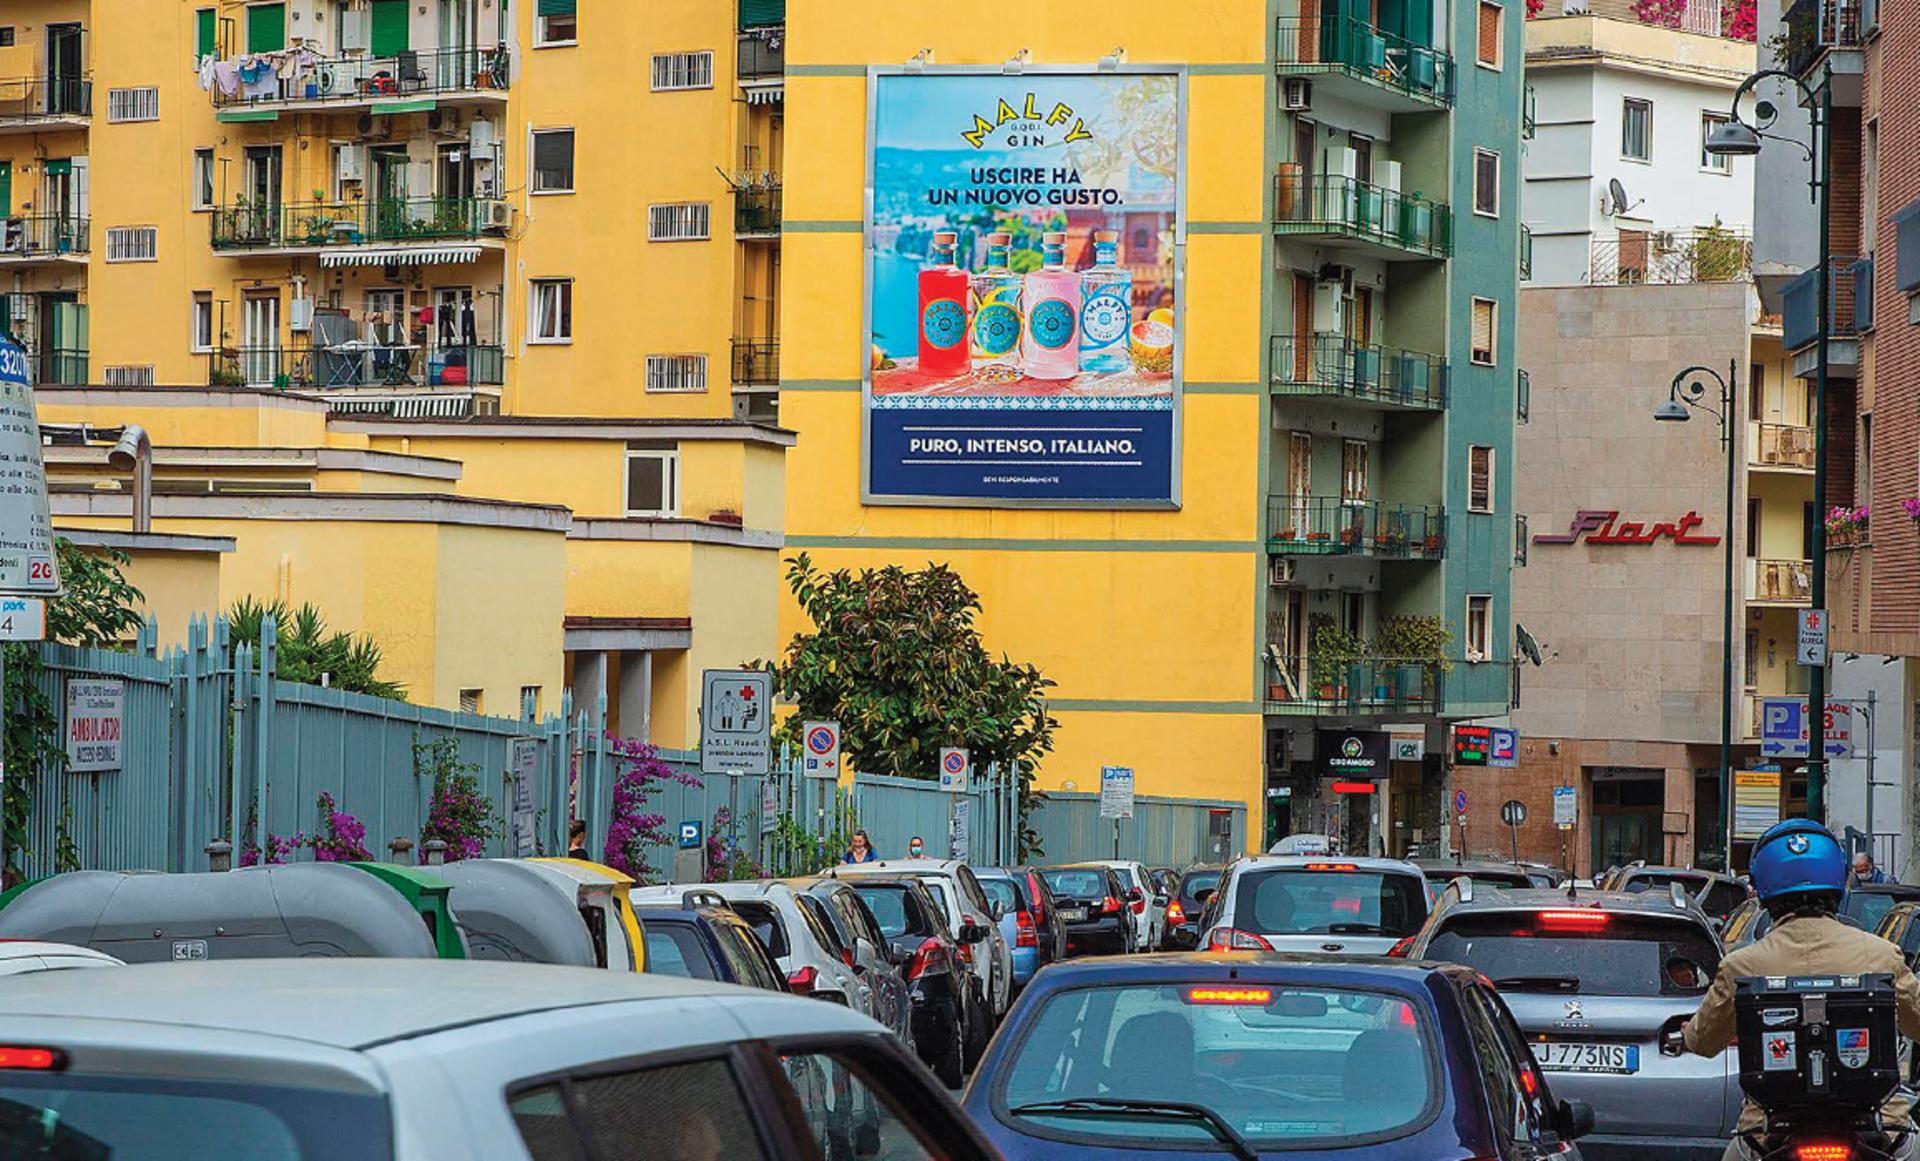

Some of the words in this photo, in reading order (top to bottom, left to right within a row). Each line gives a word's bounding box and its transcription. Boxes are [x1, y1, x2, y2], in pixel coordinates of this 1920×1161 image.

[961, 93, 1093, 149] MALFY
[1007, 135, 1044, 147] GIN
[971, 167, 1045, 185] USCIRE
[1052, 167, 1082, 185] HA
[928, 188, 957, 205] UN
[965, 188, 1042, 206] NUOVO
[1047, 188, 1124, 206] GUSTO.
[910, 438, 962, 455] PURO,
[966, 438, 1047, 456] INTENSO,
[1051, 439, 1136, 455] ITALIANO.
[1533, 510, 1721, 544] Fiart
[1, 616, 13, 634] 4
[1767, 707, 1789, 733] P
[682, 825, 697, 842] P
